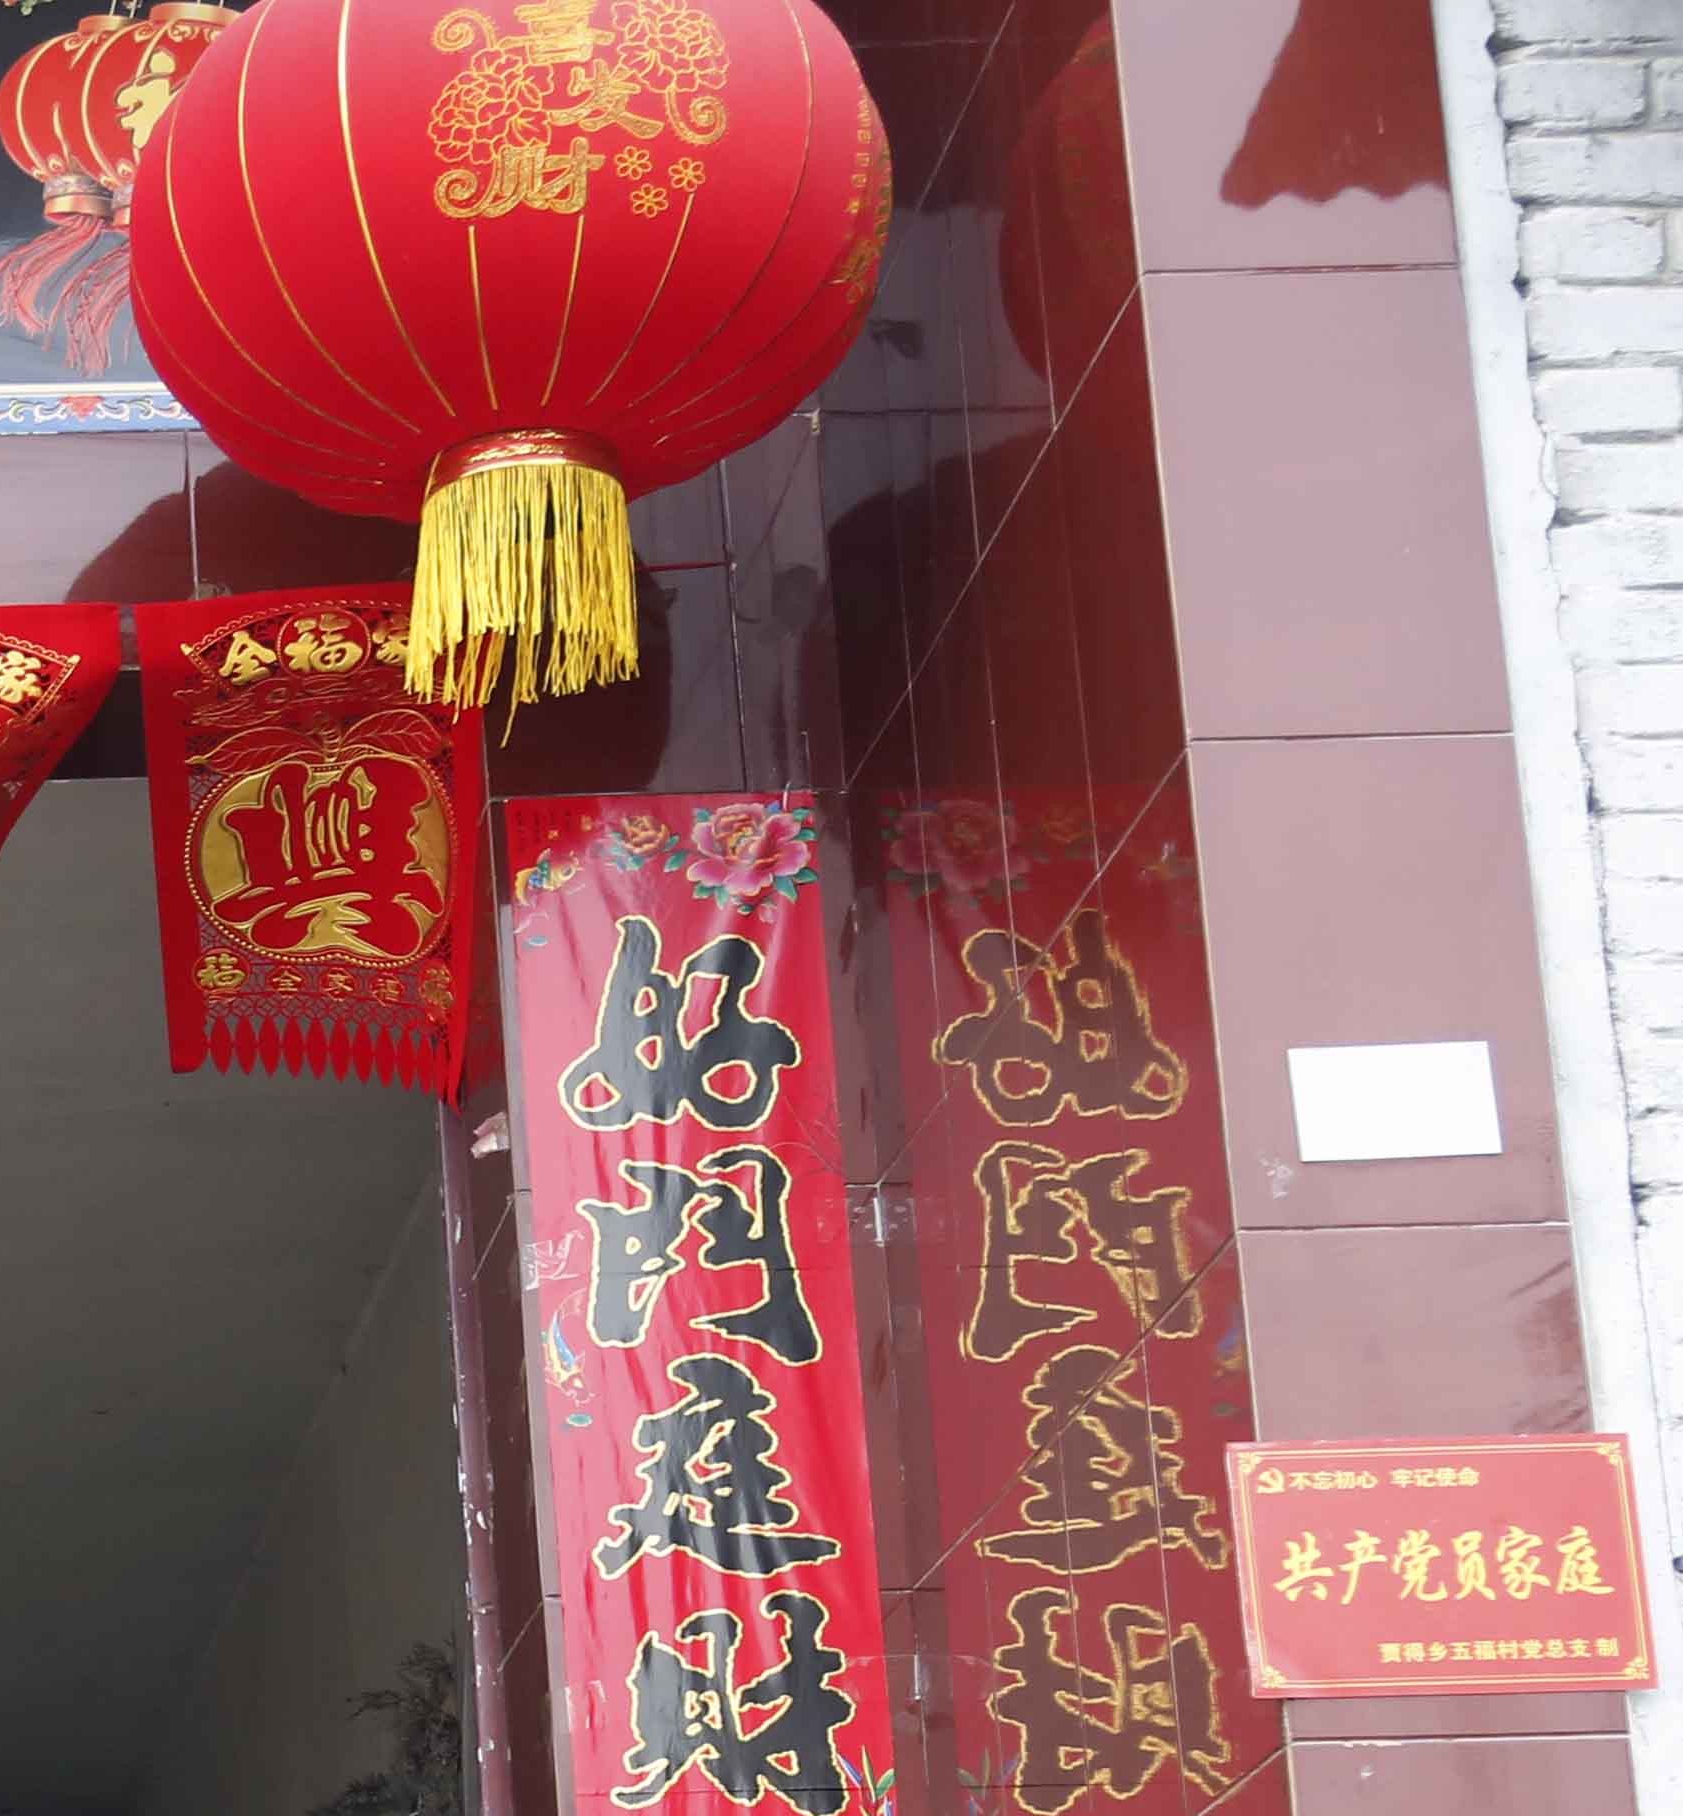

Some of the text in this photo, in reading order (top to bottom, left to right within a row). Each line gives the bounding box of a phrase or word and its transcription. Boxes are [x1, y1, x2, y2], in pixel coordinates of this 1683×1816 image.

[1289, 1467, 1480, 1491] 不忘初心 牢记使命
[1273, 1525, 1616, 1606] 共产党员家庭
